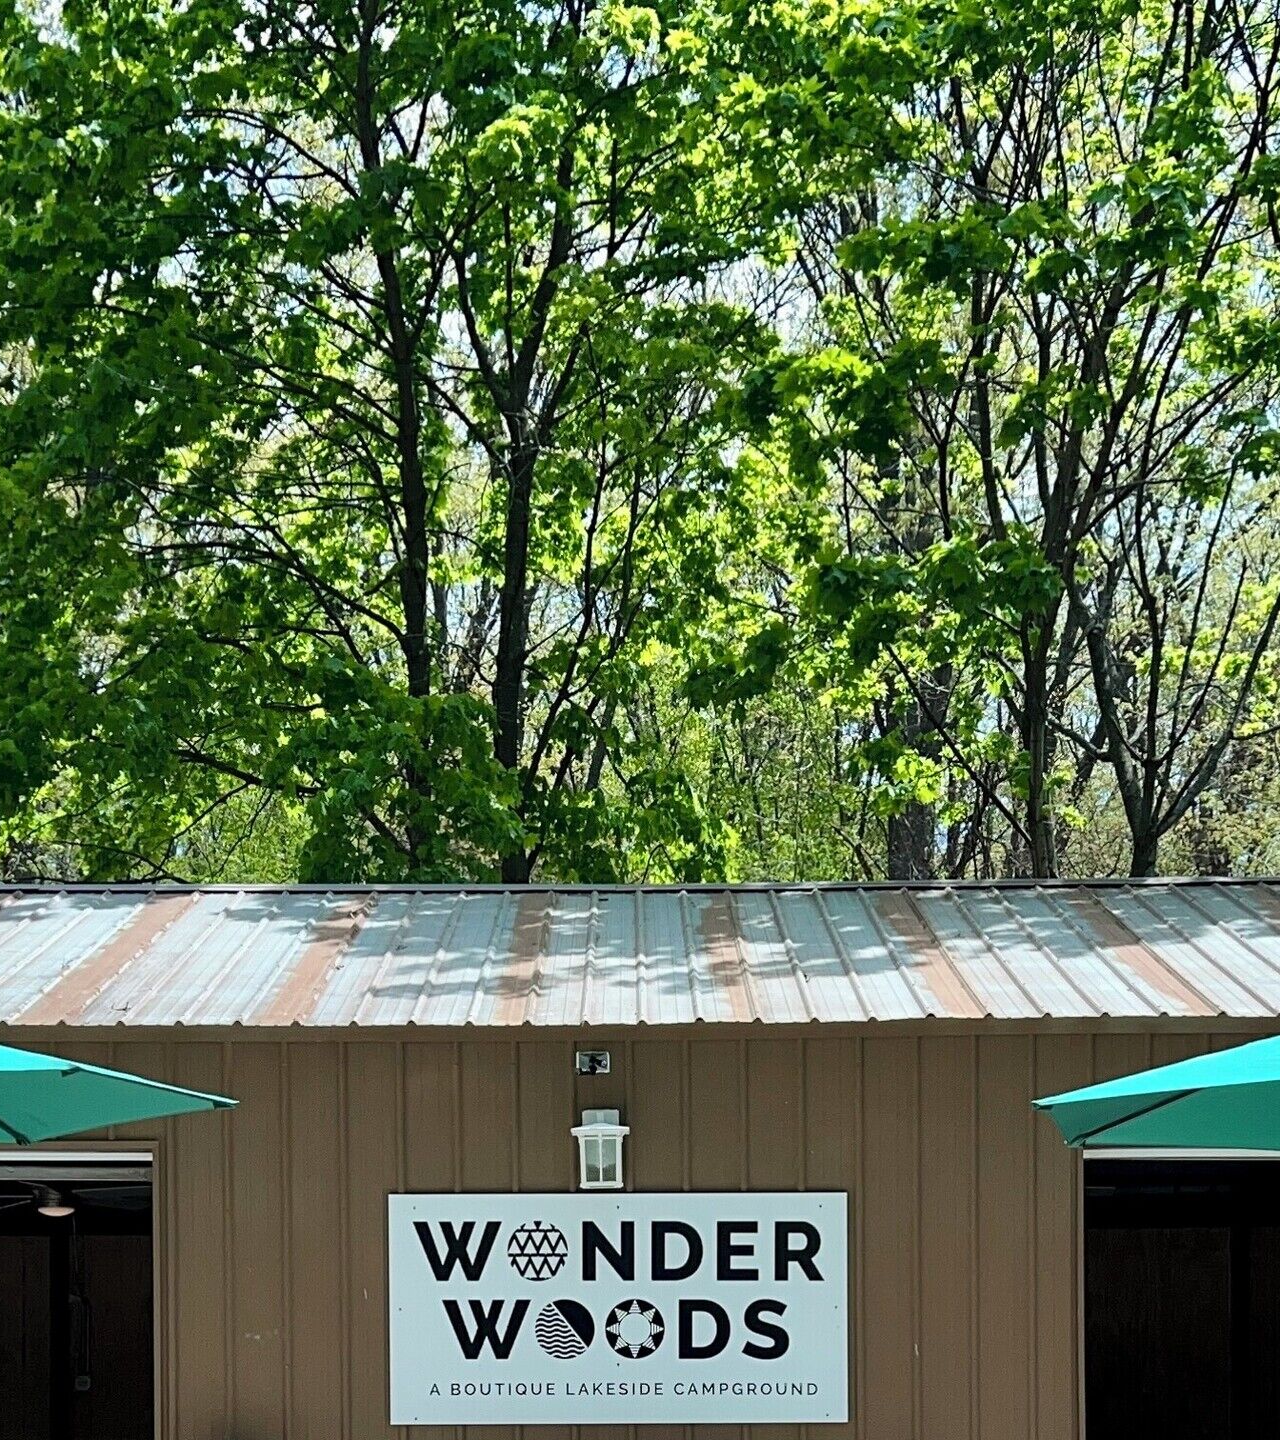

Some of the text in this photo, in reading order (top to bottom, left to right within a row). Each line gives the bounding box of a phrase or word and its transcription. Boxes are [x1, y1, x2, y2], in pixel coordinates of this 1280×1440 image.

[412, 1220, 825, 1282] WONDER
[441, 1298, 790, 1360] WOODS
[429, 1382, 818, 1397] A BOUTIQUE LAKESIDE CAMPGROUND
